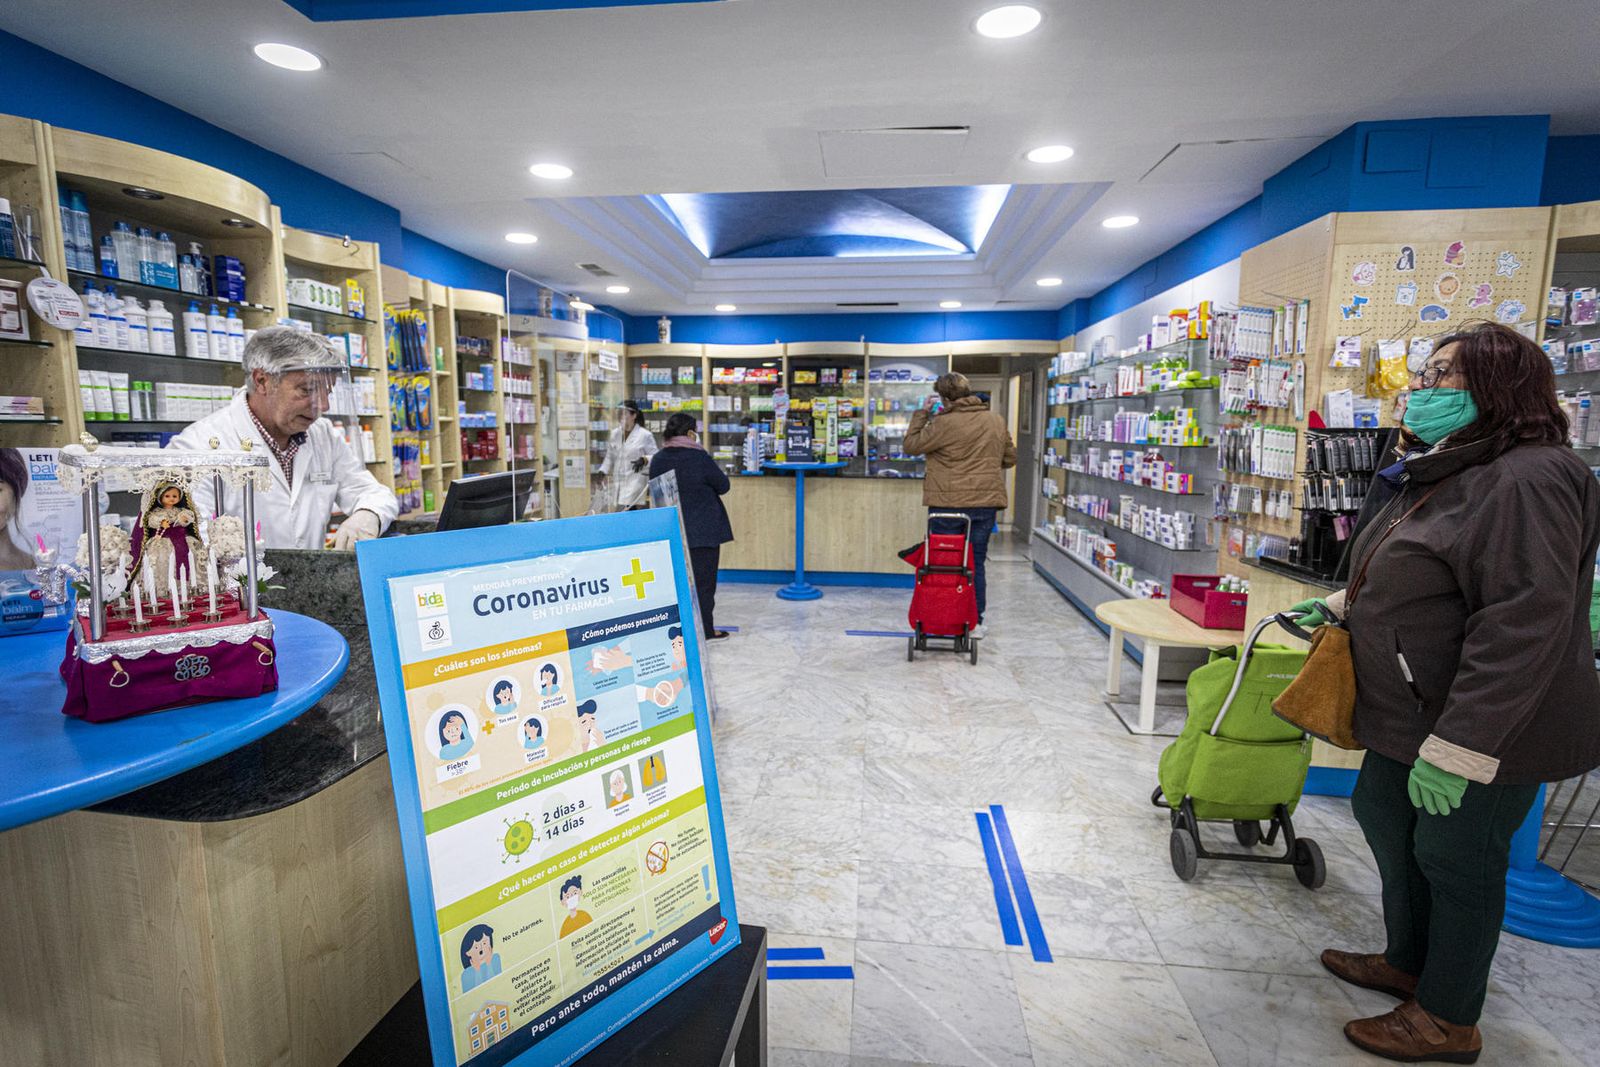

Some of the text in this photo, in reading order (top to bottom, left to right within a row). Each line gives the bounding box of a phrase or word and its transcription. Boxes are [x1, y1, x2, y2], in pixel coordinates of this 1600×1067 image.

[473, 578, 609, 616] Coronavirus
[533, 597, 614, 620] EN TU FARMACIA
[582, 612, 669, 641] ¿Cómo podemos prevenirla?
[433, 641, 543, 677] ¿Cuáles son los síntomas?
[447, 760, 469, 771] Fiebre
[531, 777, 541, 787] de
[543, 762, 583, 782] incubación
[584, 759, 589, 768] y
[590, 747, 621, 766] personas
[621, 743, 631, 752] de
[631, 736, 651, 748] riesgo
[542, 800, 585, 824] 2 días a
[546, 816, 585, 839] 14 días
[498, 881, 520, 900] ¿Qué
[522, 870, 545, 887] hacer
[547, 865, 558, 874] en
[559, 856, 577, 868] caso
[578, 849, 588, 859] de
[589, 834, 621, 854] detectar
[621, 824, 641, 839] algún
[592, 866, 627, 887] Las mascarillas
[606, 878, 631, 894] PERSONAS
[502, 934, 511, 942] No
[520, 918, 544, 934] alarmes.
[571, 936, 584, 947] Evita
[585, 928, 600, 939] acudir
[600, 910, 630, 930] directamente
[586, 934, 602, 945] centro
[709, 920, 727, 937] Lacer
[576, 944, 598, 960] Consulta
[576, 947, 604, 967] información
[584, 957, 600, 968] región
[511, 957, 551, 983] Permanece en
[514, 966, 550, 990] casa, intenta
[516, 980, 552, 1004] ventilar para
[521, 977, 542, 993] aislarte
[531, 1016, 557, 1037] Pero
[558, 999, 580, 1019] ante
[582, 983, 608, 1003] todo,
[609, 961, 642, 987] mantén
[643, 953, 652, 964] la
[653, 938, 680, 958] calma.
[513, 984, 556, 1013] evitar expandir
